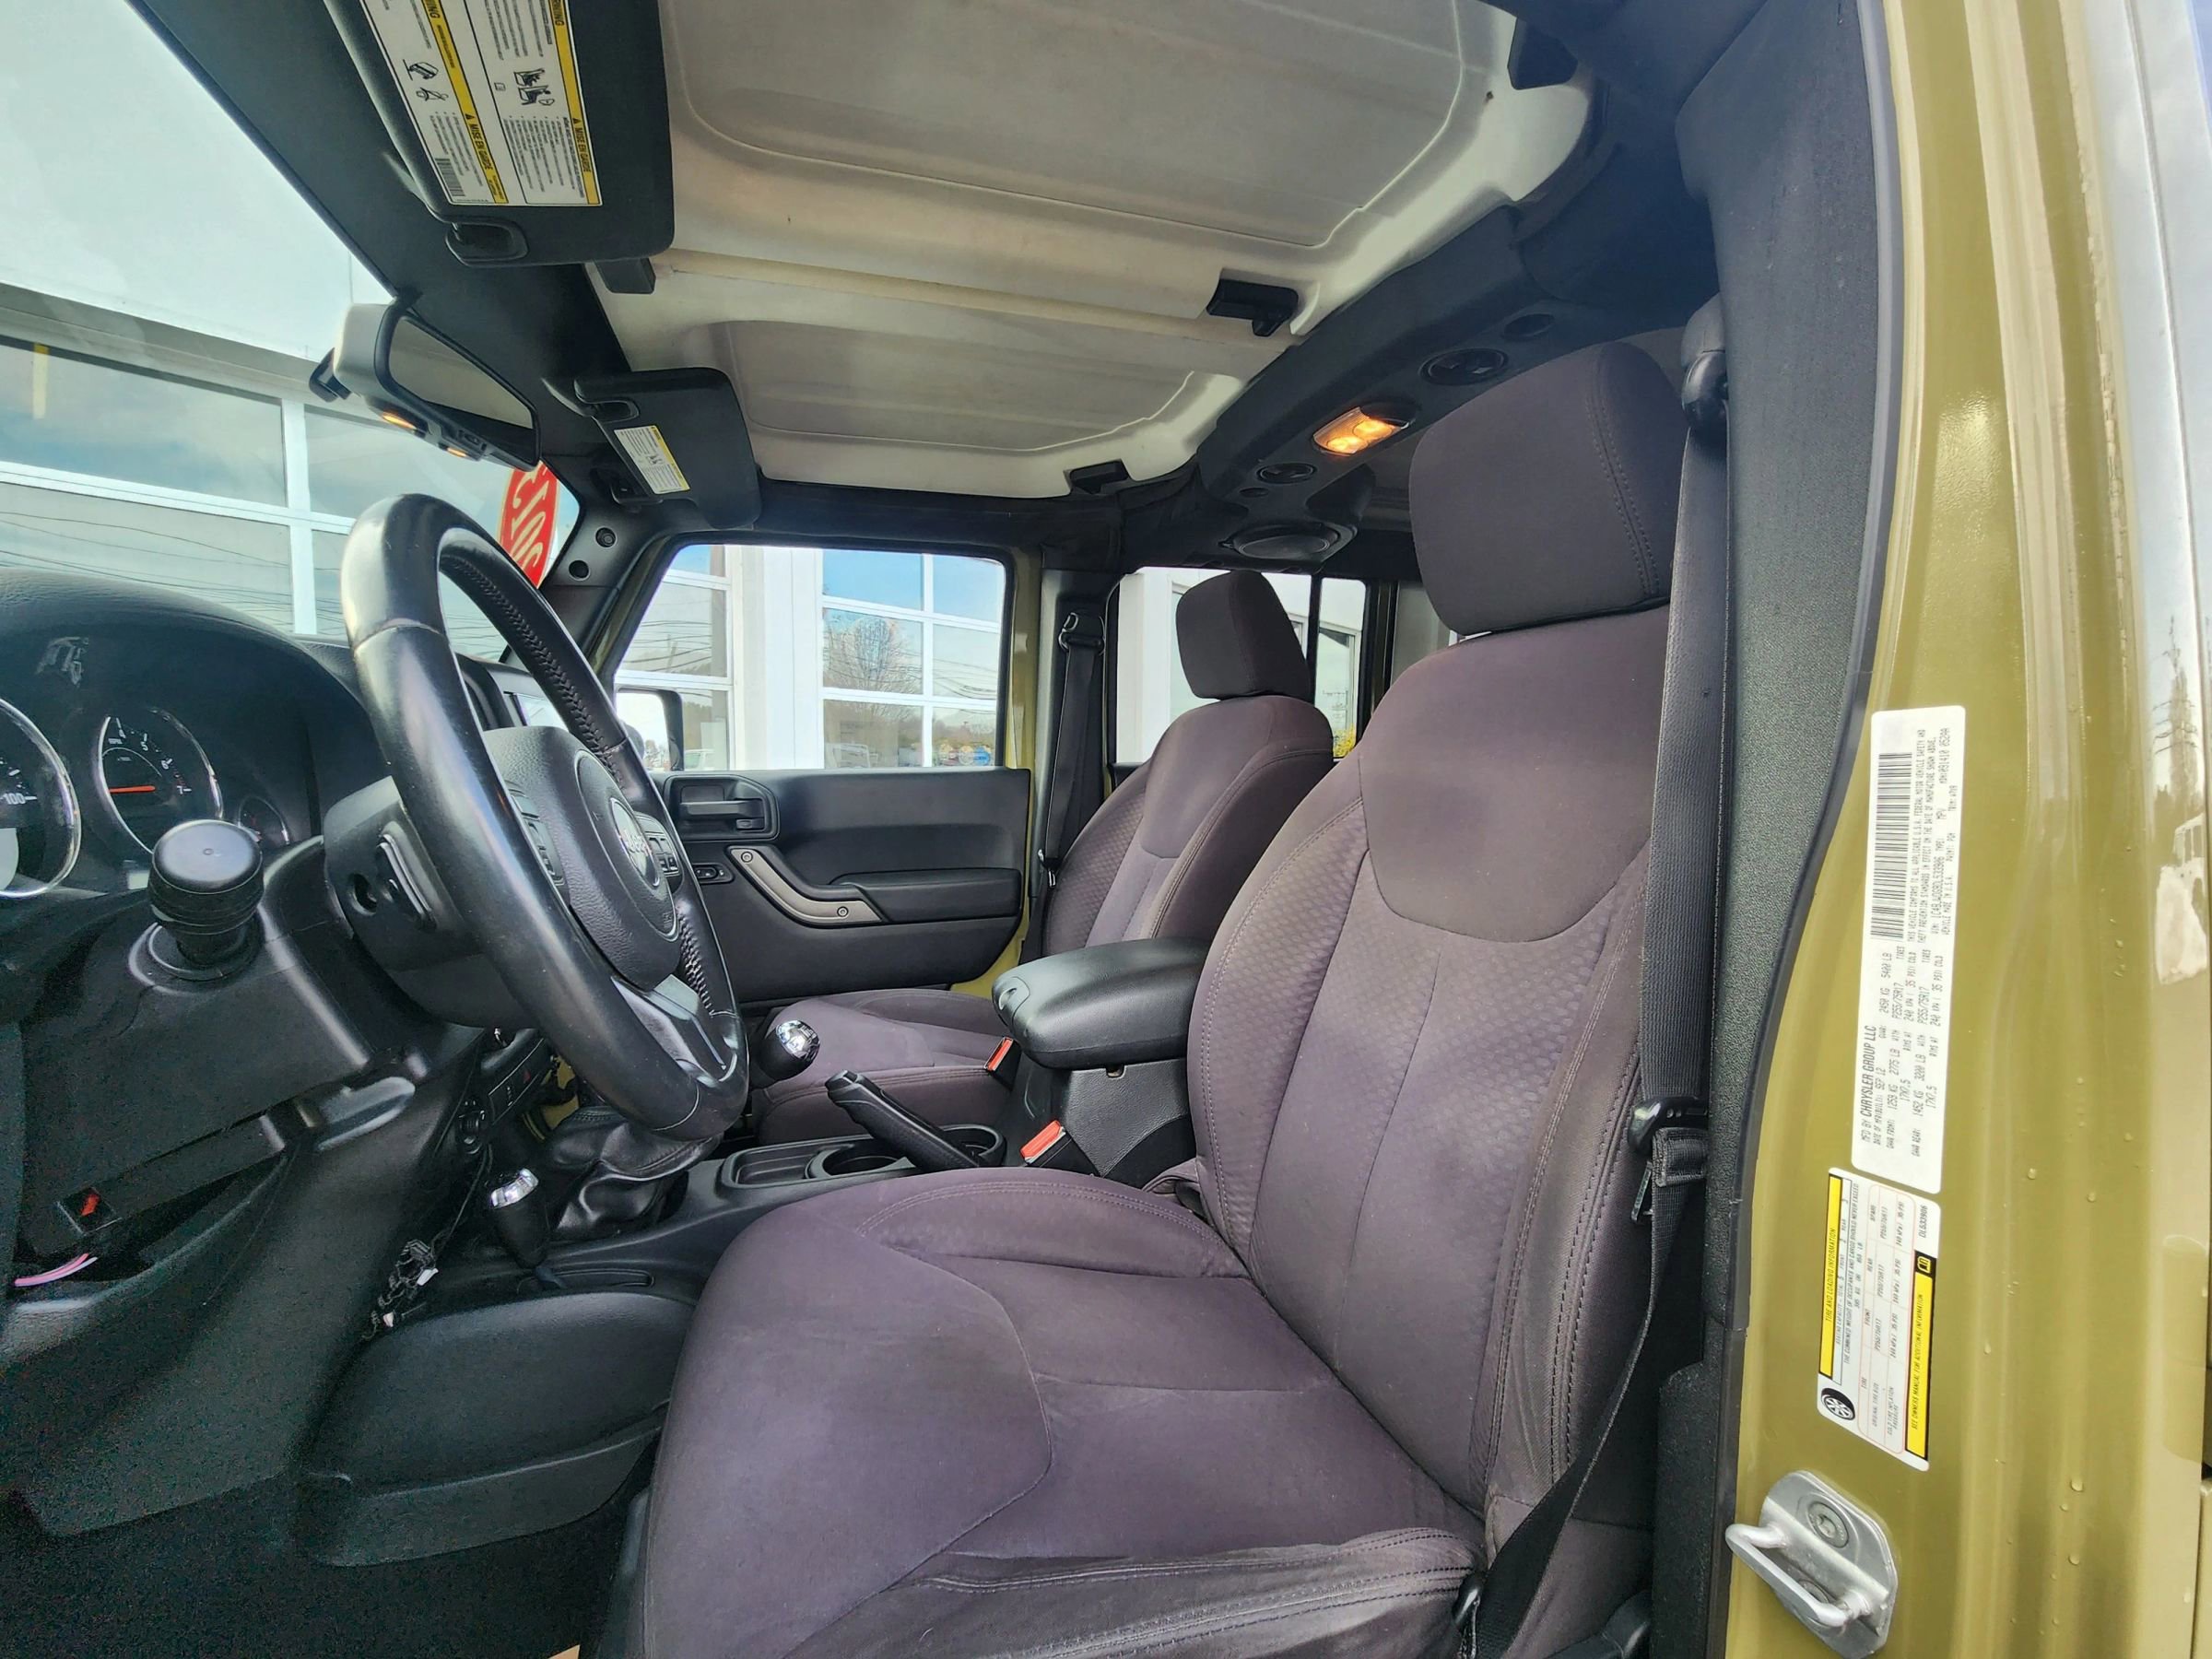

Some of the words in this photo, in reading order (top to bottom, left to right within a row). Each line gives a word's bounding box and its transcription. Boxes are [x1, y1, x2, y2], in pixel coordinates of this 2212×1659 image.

[468, 124, 482, 143] MISE
[574, 127, 586, 143] MISE
[476, 141, 485, 150] EN
[578, 142, 587, 151] EN
[477, 149, 493, 171] GARDE
[580, 151, 592, 172] GARDE
[1917, 729, 1925, 737] AND
[140, 741, 149, 751] 5
[1916, 740, 1924, 756] SAFETY
[160, 759, 170, 770] 6
[1915, 759, 1924, 778] VEHICLE
[1925, 756, 1935, 770] SHOWN
[1914, 780, 1923, 794] MOTOR
[1924, 771, 1934, 803] MANUFACTURE
[3, 793, 26, 805] 100
[1913, 796, 1922, 816] FEDERAL
[1924, 812, 1932, 824] DATE
[1936, 807, 1946, 819] MPV
[1911, 837, 1920, 865] APPLICABLE
[1922, 845, 1931, 862] EFFECT
[1911, 866, 1919, 876] ALL
[1920, 872, 1929, 898] STANDARDS
[1909, 885, 1918, 907] CONFORMS
[1942, 900, 1951, 912] MADE
[1908, 909, 1917, 929] VEHICLE
[1918, 899, 1928, 928] PREVENTION
[1941, 914, 1950, 935] VEHICLE
[1907, 931, 1916, 942] THIS
[1917, 929, 1926, 943] THEFT
[1881, 951, 1891, 961] LB
[1895, 945, 1904, 959] TIRES
[1907, 951, 1915, 963] COLD
[1921, 948, 1931, 963] TIRES
[1934, 954, 1943, 967] COLD
[1880, 962, 1891, 979] 5400
[1879, 986, 1889, 995] KG
[1904, 979, 1915, 988] 35
[1931, 982, 1943, 992] 35
[1878, 997, 1889, 1013] 2450
[1891, 982, 1904, 1019] P255/75R17
[1917, 985, 1930, 1025] P255/75R17
[1902, 1008, 1914, 1022] 240
[1929, 1013, 1941, 1027] 240
[1864, 1024, 1876, 1041] LLC
[1891, 1028, 1900, 1041] WITH
[1902, 1039, 1912, 1052] RIMS
[1916, 1033, 1925, 1047] WITH
[1862, 1041, 1875, 1072] GROUP
[1889, 1047, 1900, 1057] LB
[1929, 1043, 1938, 1057] RIMS
[1914, 1053, 1925, 1064] LB
[1875, 1066, 1885, 1076] 12
[1888, 1058, 1899, 1076] 2775
[1913, 1064, 1924, 1081] 3200
[1875, 1076, 1885, 1090] SEP
[1888, 1083, 1898, 1093] KG
[1899, 1077, 1911, 1101] 17X7.5
[1860, 1072, 1873, 1117] CHRYSLER
[1912, 1088, 1924, 1099] KG
[1924, 1084, 1936, 1109] 17X7.5
[1887, 1093, 1898, 1110] 1259
[1912, 1100, 1924, 1116] 1452
[1861, 1118, 1871, 1128] BY
[1861, 1128, 1871, 1142] MFD
[1873, 1132, 1881, 1145] DATE
[1827, 1227, 1836, 1268] INFORMATION
[1826, 1267, 1834, 1295] LOADING
[1846, 1299, 1853, 1308] OF
[1914, 1291, 1924, 1330] INFORMATION
[1913, 1329, 1922, 1361] ADDITIONAL
[1911, 1394, 1919, 1419] OWNERS
